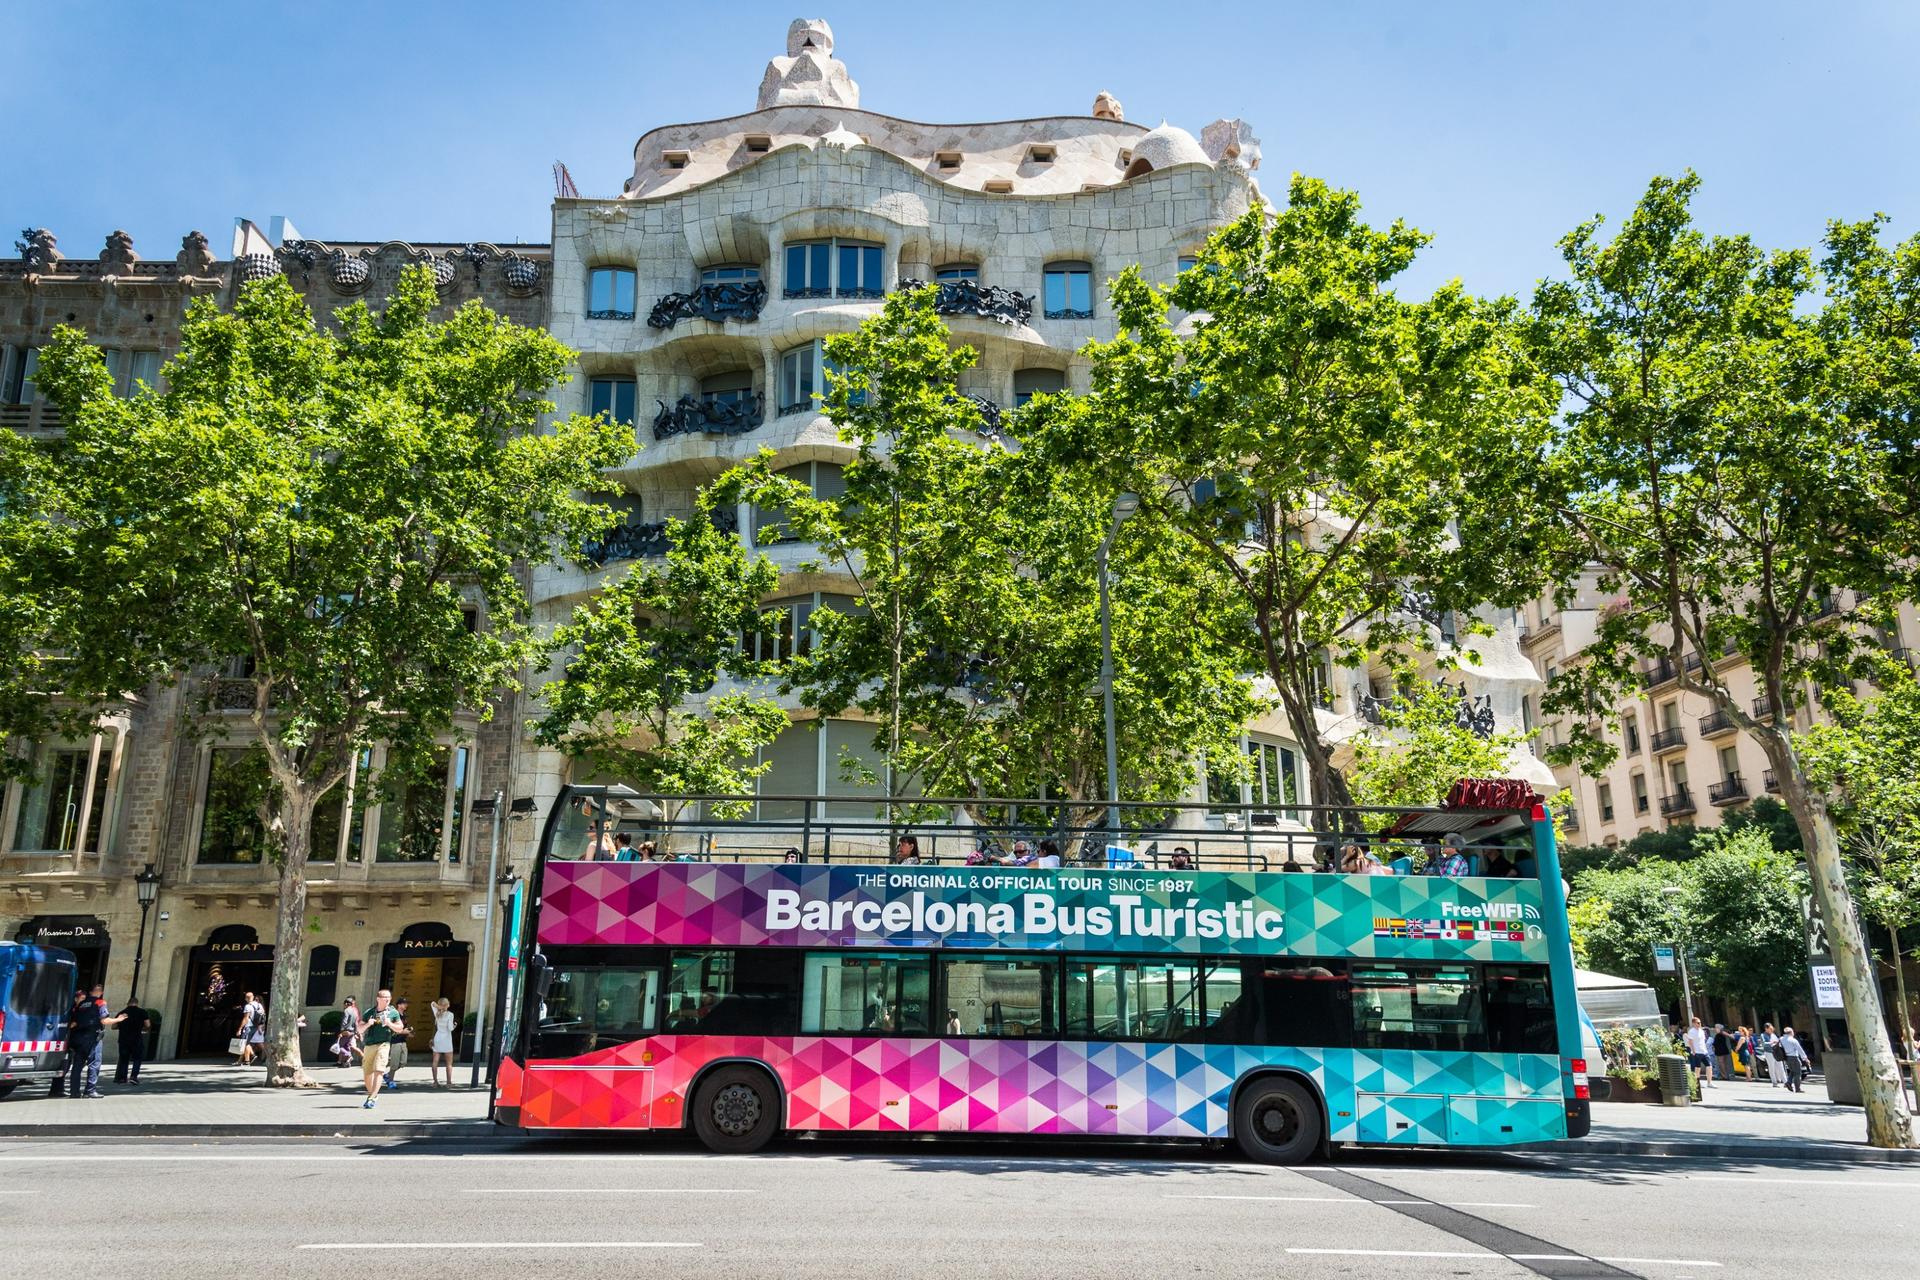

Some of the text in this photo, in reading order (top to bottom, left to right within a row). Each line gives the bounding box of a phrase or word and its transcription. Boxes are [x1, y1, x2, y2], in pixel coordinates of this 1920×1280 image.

[856, 873, 1194, 893] THE ORIGINAL & OFFICIAL TOUR SINCE 1987
[765, 889, 1284, 940] Barcelona BusTurístic
[1441, 901, 1523, 919] FreeWIFI
[37, 926, 96, 937] Massimo Dutti
[211, 943, 260, 952] RABAT
[405, 940, 452, 949] RABAT
[1818, 977, 1837, 985] ZOOTR
